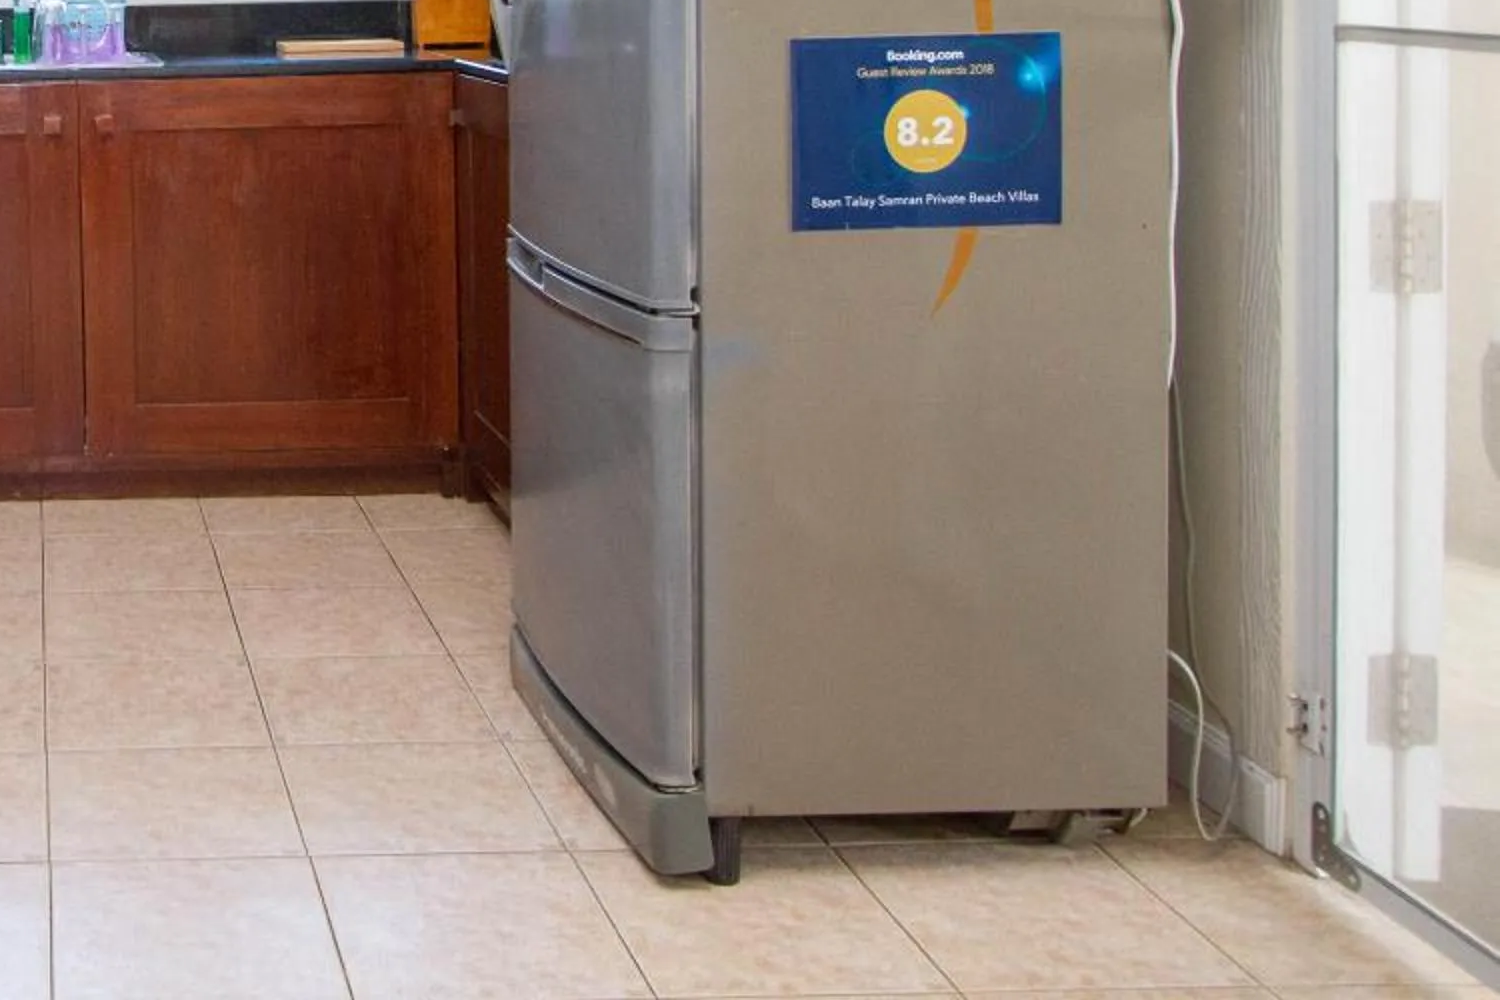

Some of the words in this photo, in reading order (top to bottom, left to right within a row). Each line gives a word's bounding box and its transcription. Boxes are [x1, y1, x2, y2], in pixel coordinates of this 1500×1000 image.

[886, 49, 965, 62] Booking.com
[891, 65, 927, 77] Review
[930, 64, 967, 75] Awards
[897, 116, 954, 147] 8.2
[844, 195, 876, 209] Talay
[925, 193, 967, 205] Private
[969, 191, 1003, 204] Beach
[1007, 190, 1039, 202] Villas
